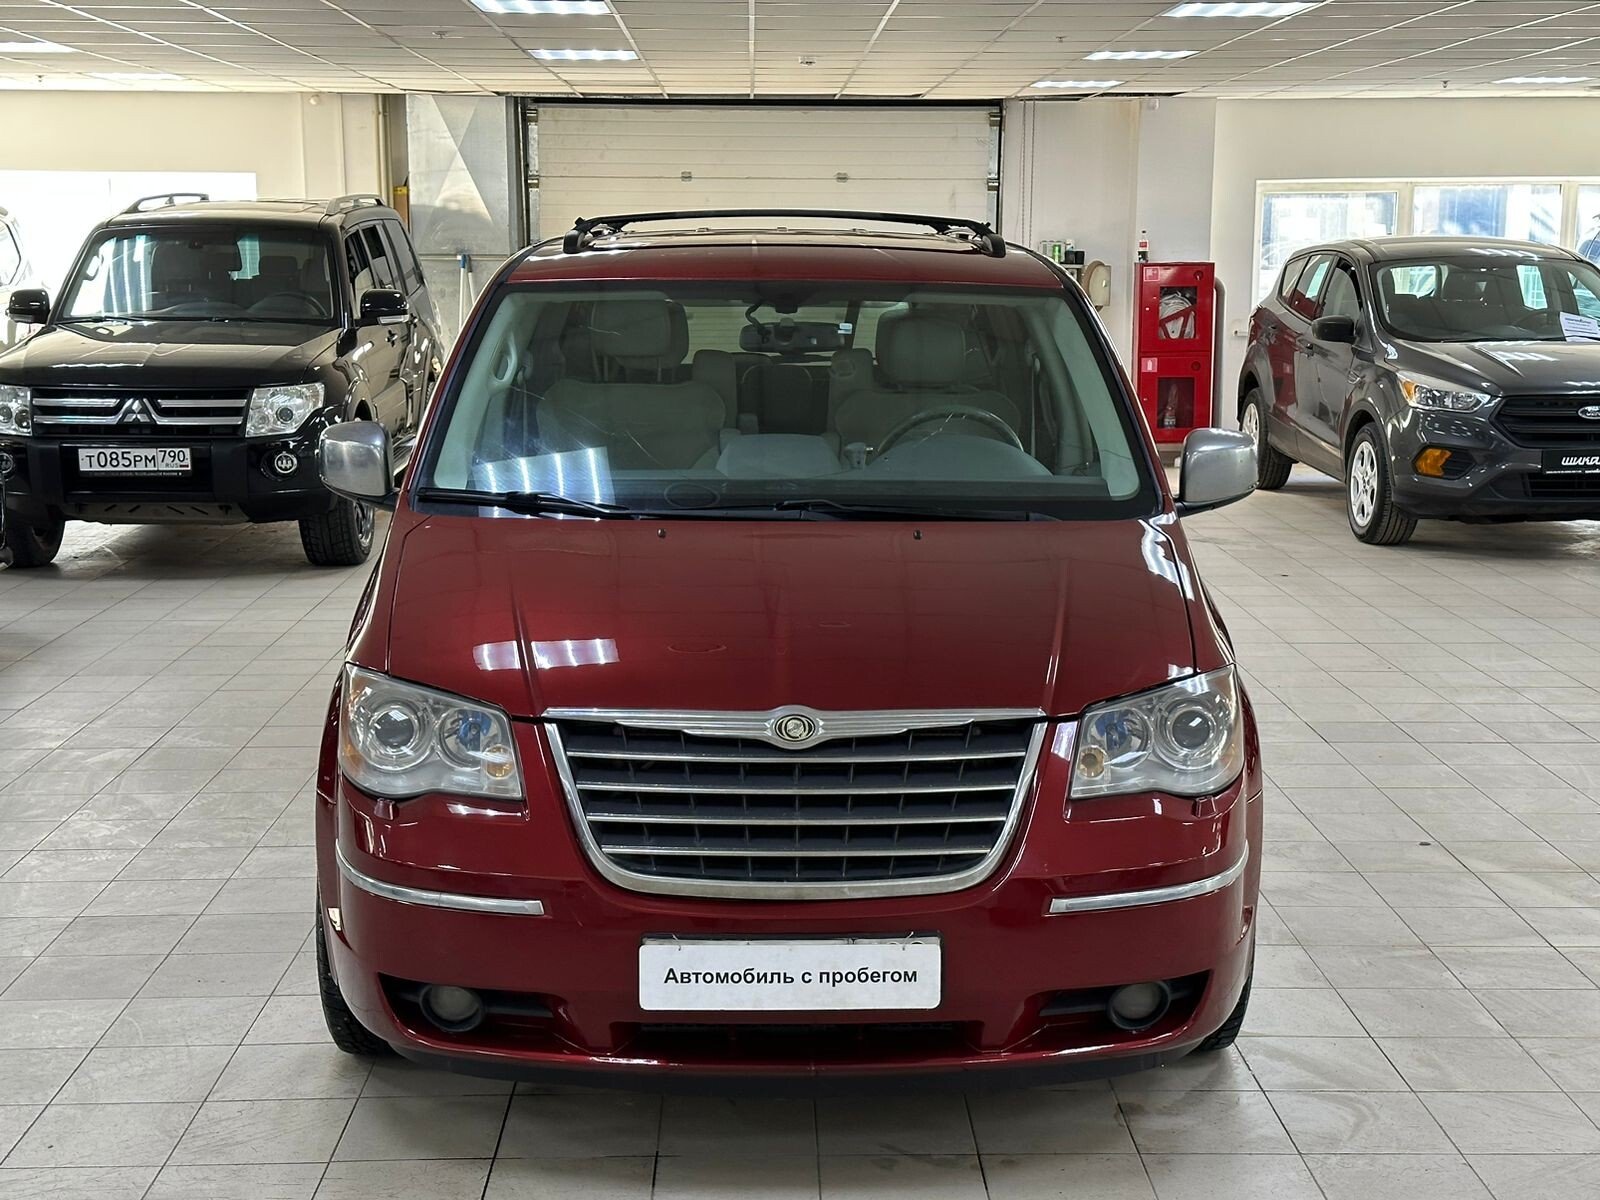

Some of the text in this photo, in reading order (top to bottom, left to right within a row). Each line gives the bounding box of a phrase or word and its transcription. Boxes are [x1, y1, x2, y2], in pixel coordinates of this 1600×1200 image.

[158, 450, 186, 463] 790
[664, 966, 917, 987] Автомобиль с пробегом
